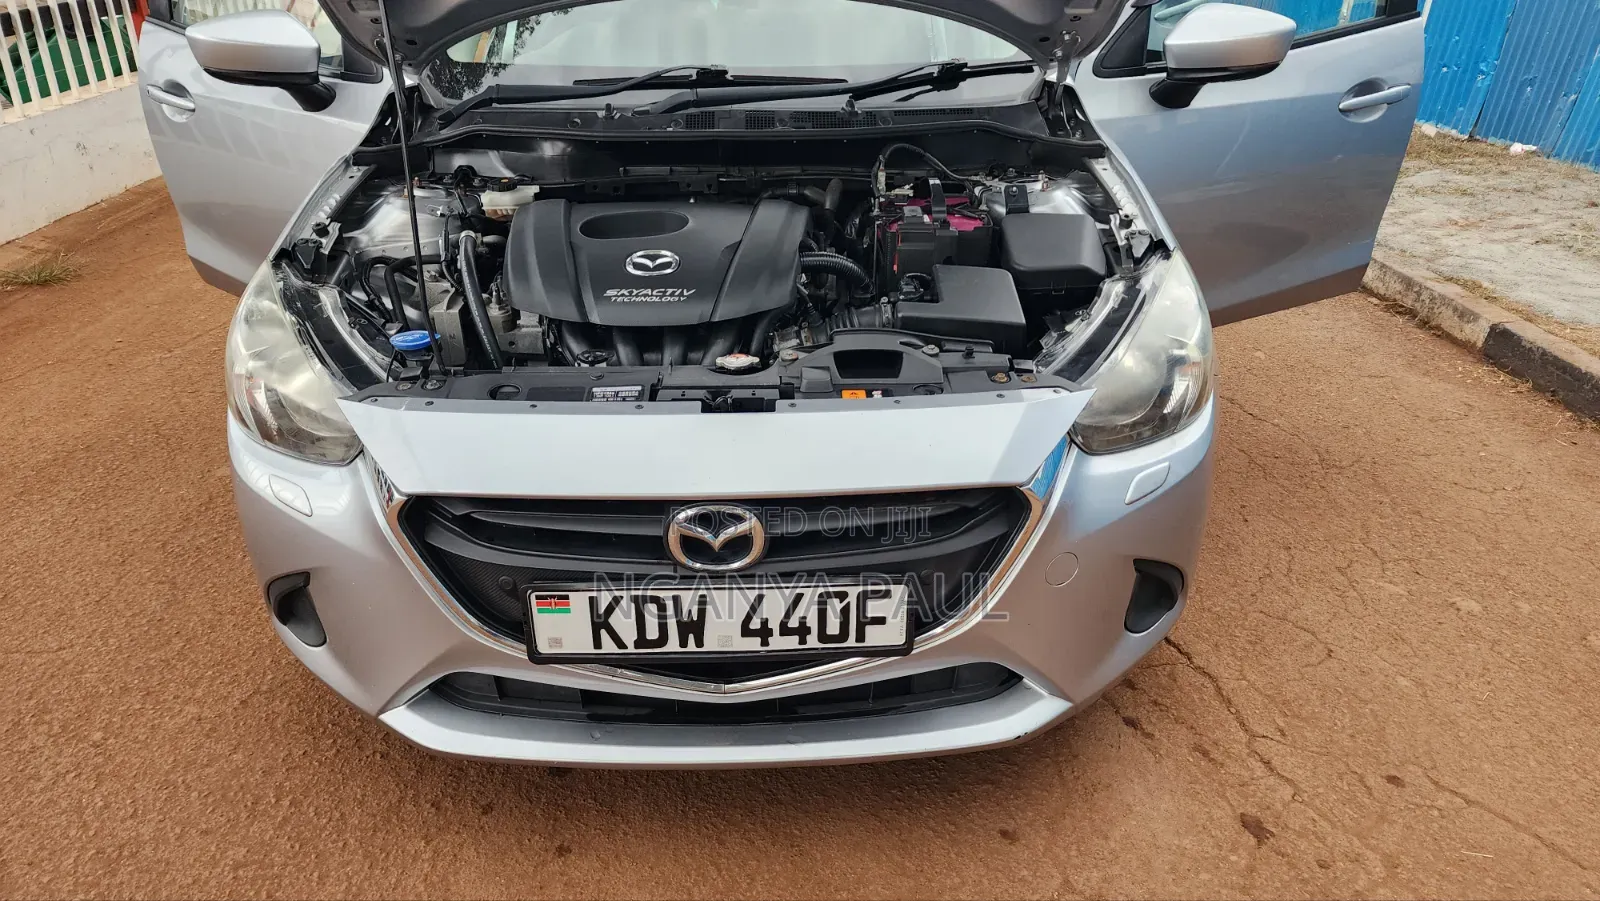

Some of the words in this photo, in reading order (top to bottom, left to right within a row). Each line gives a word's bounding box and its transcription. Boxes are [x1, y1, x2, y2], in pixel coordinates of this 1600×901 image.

[603, 288, 697, 297] SKYACTIV
[588, 594, 708, 650] KDW
[740, 589, 892, 647] 440F
